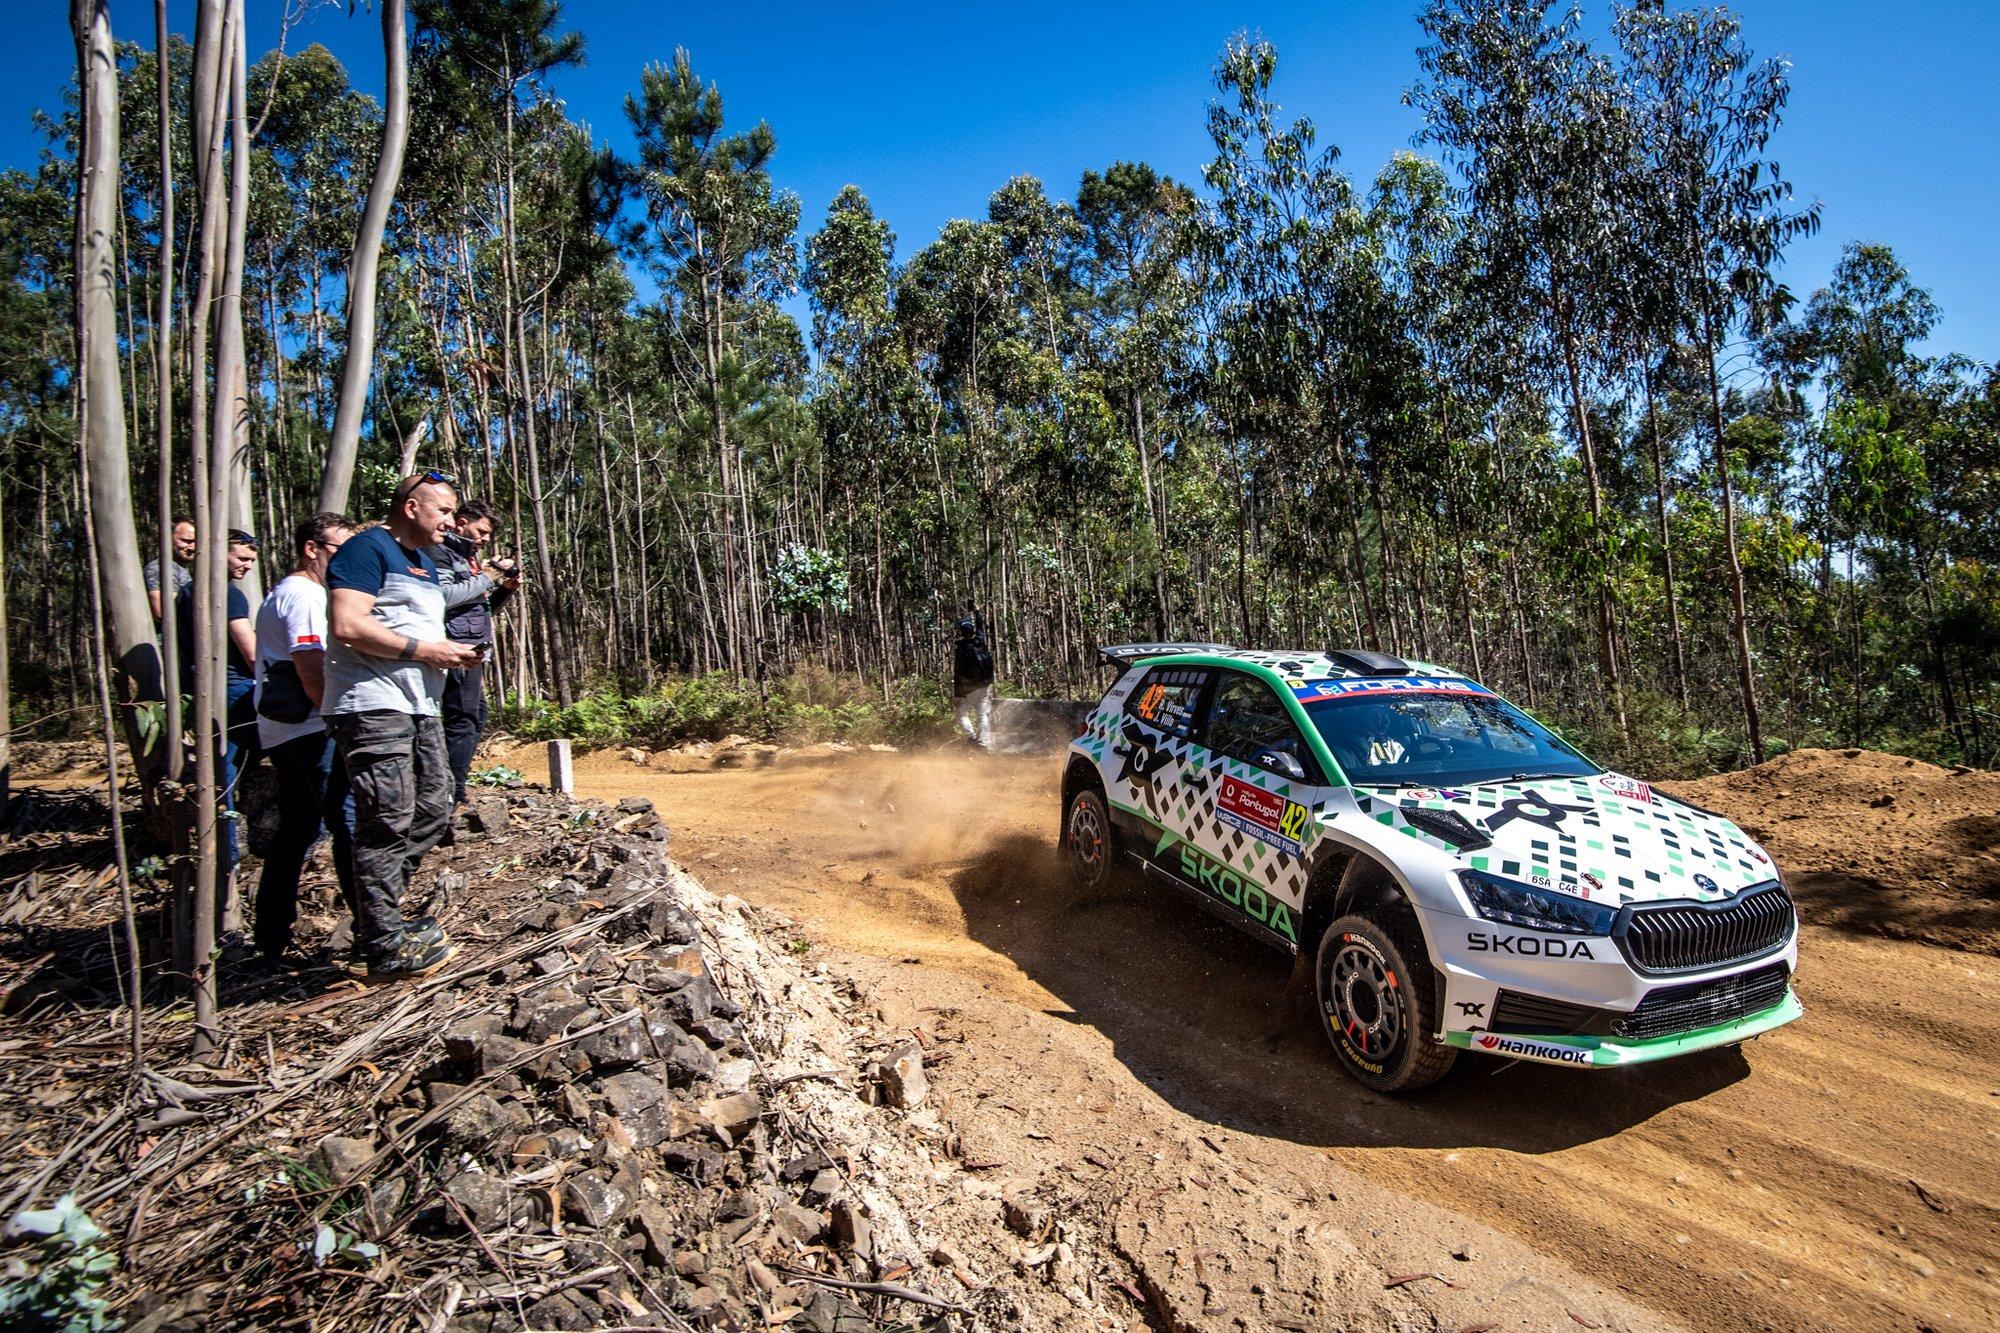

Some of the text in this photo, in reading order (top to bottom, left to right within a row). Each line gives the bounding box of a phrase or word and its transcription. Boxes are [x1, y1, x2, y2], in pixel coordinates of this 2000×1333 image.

[1339, 679, 1472, 692] FORUM8
[1137, 684, 1164, 719] 42
[1239, 794, 1279, 819] Portugal
[1281, 803, 1308, 841] 42
[1245, 823, 1297, 856] FOSSIL-FREE FUEL
[1532, 876, 1578, 894] 6SA C4E
